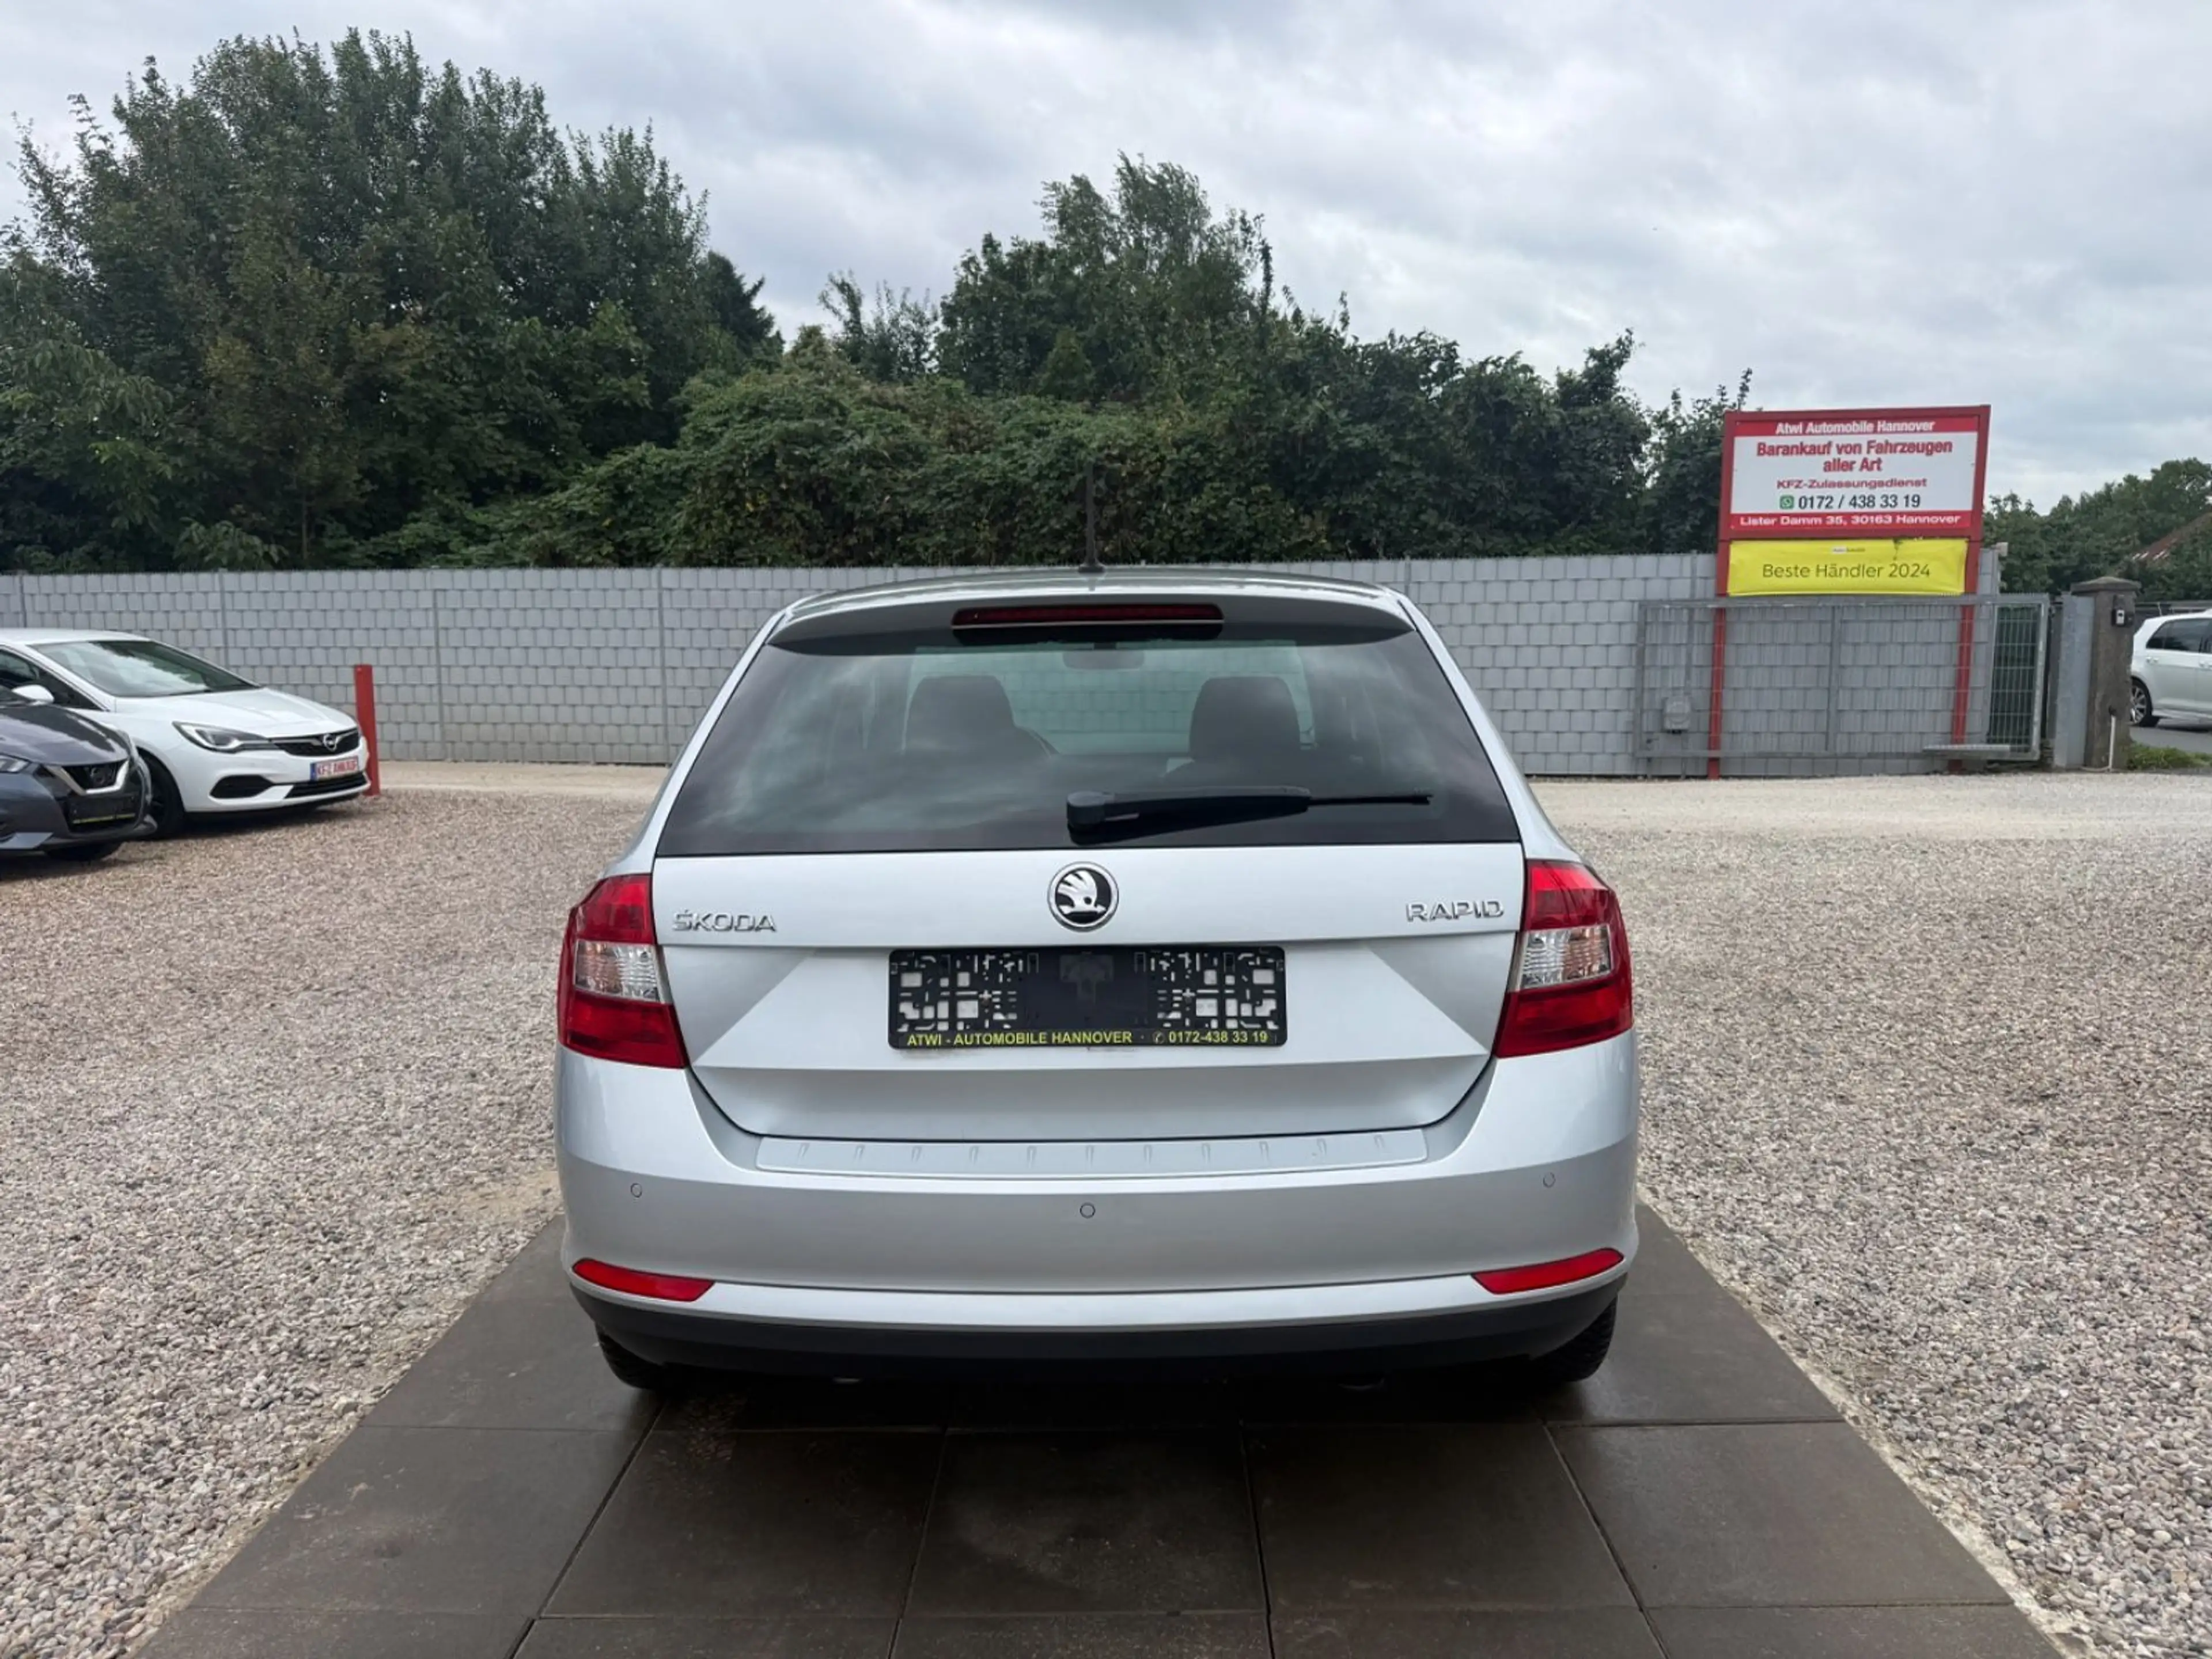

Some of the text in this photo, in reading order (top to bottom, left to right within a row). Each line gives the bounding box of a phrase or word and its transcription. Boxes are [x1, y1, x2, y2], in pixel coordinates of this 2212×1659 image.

[1805, 420, 1874, 434] Automobile
[1877, 420, 1936, 432] Hannover
[1757, 439, 1953, 456] Barankauf von Fahrzeugen
[1823, 457, 1883, 472] aller Art
[1777, 478, 1927, 490] KFZ-Zulassungsdienst
[1798, 495, 1834, 510] 0172
[1849, 494, 1876, 509] 438
[1880, 494, 1899, 509] 33
[1903, 494, 1921, 508] 19
[1740, 516, 1777, 527] Lister
[1781, 516, 1823, 525] Damm
[1850, 514, 1893, 525] 30163
[1895, 514, 1962, 525] Hannover
[1762, 562, 1931, 578] Beste Händler 2024
[1406, 900, 1504, 922] RAPID
[672, 909, 777, 932] ŠKODA
[907, 1034, 941, 1046] ATWI
[953, 1032, 1047, 1046] AUTOMOBILE
[1052, 1031, 1132, 1044] HANNOVER
[1168, 1031, 1229, 1044] 0172-438
[1232, 1031, 1248, 1043] 33
[1253, 1031, 1268, 1043] 19
